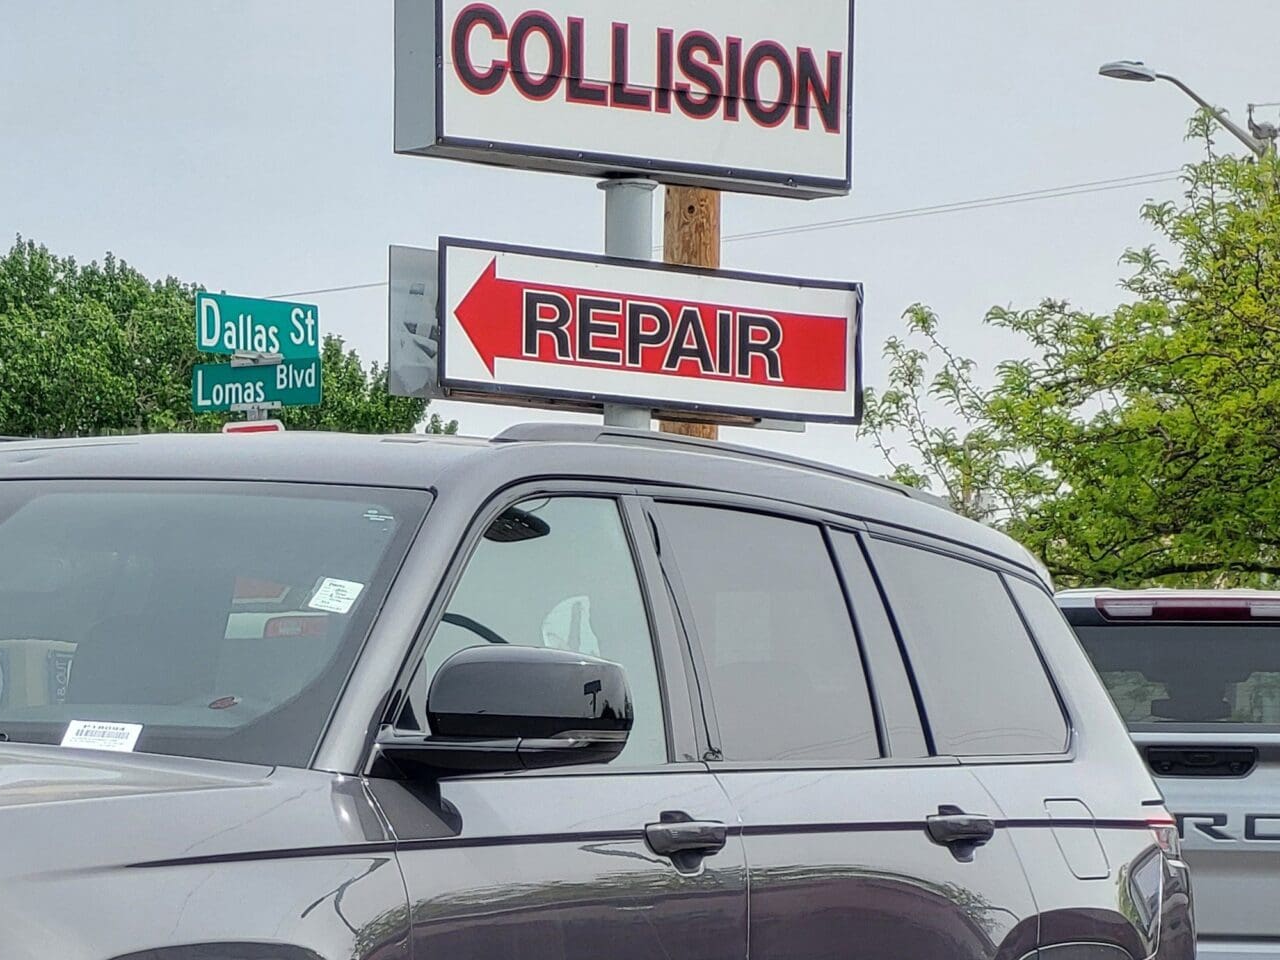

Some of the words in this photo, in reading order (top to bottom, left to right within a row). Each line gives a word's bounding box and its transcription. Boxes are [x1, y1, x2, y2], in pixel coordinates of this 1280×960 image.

[451, 3, 842, 134] COLLISION
[201, 298, 280, 353] Dallas
[290, 307, 316, 347] St
[521, 289, 785, 383] REPAIR
[197, 370, 265, 406] Lomas
[276, 362, 316, 390] Blvd
